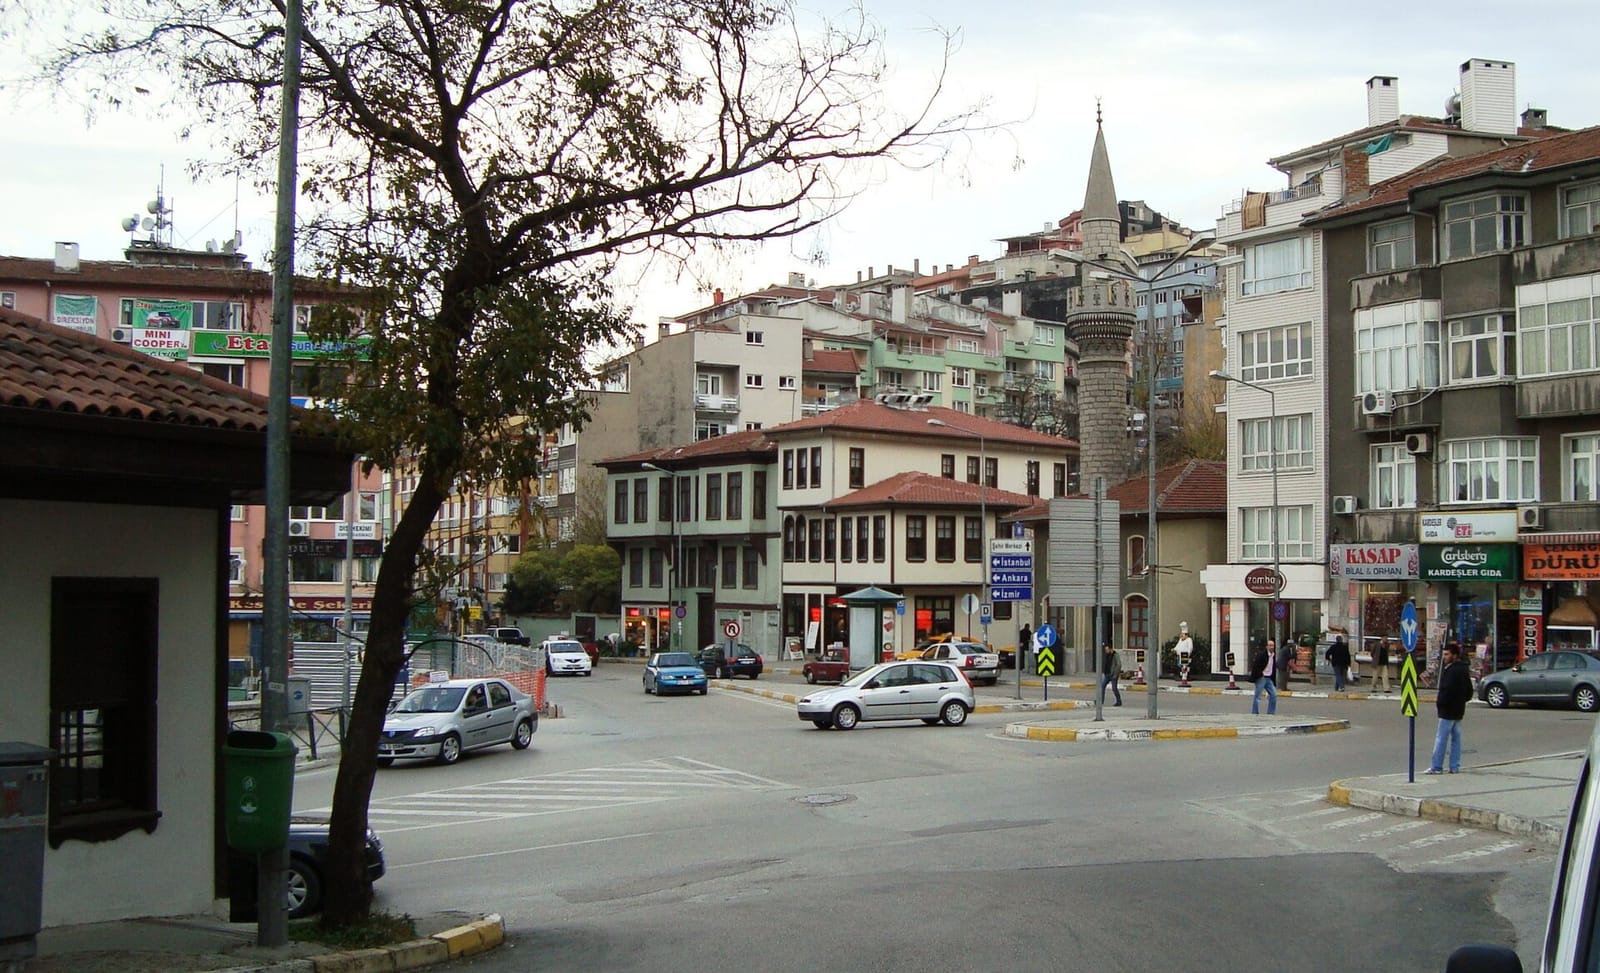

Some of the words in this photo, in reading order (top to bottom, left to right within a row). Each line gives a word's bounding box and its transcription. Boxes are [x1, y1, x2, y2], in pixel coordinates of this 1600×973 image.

[134, 339, 180, 348] COOPER
[227, 335, 270, 350] Eta
[1345, 548, 1401, 564] KASAP
[1440, 547, 1487, 564] Carlsberg
[1001, 556, 1031, 566] İstanbul
[1001, 574, 1028, 582] Ankara
[1428, 569, 1478, 578] KARDEŞLER
[1480, 569, 1501, 577] GIDA
[1248, 575, 1281, 584] zamba
[1001, 587, 1020, 597] İzmir
